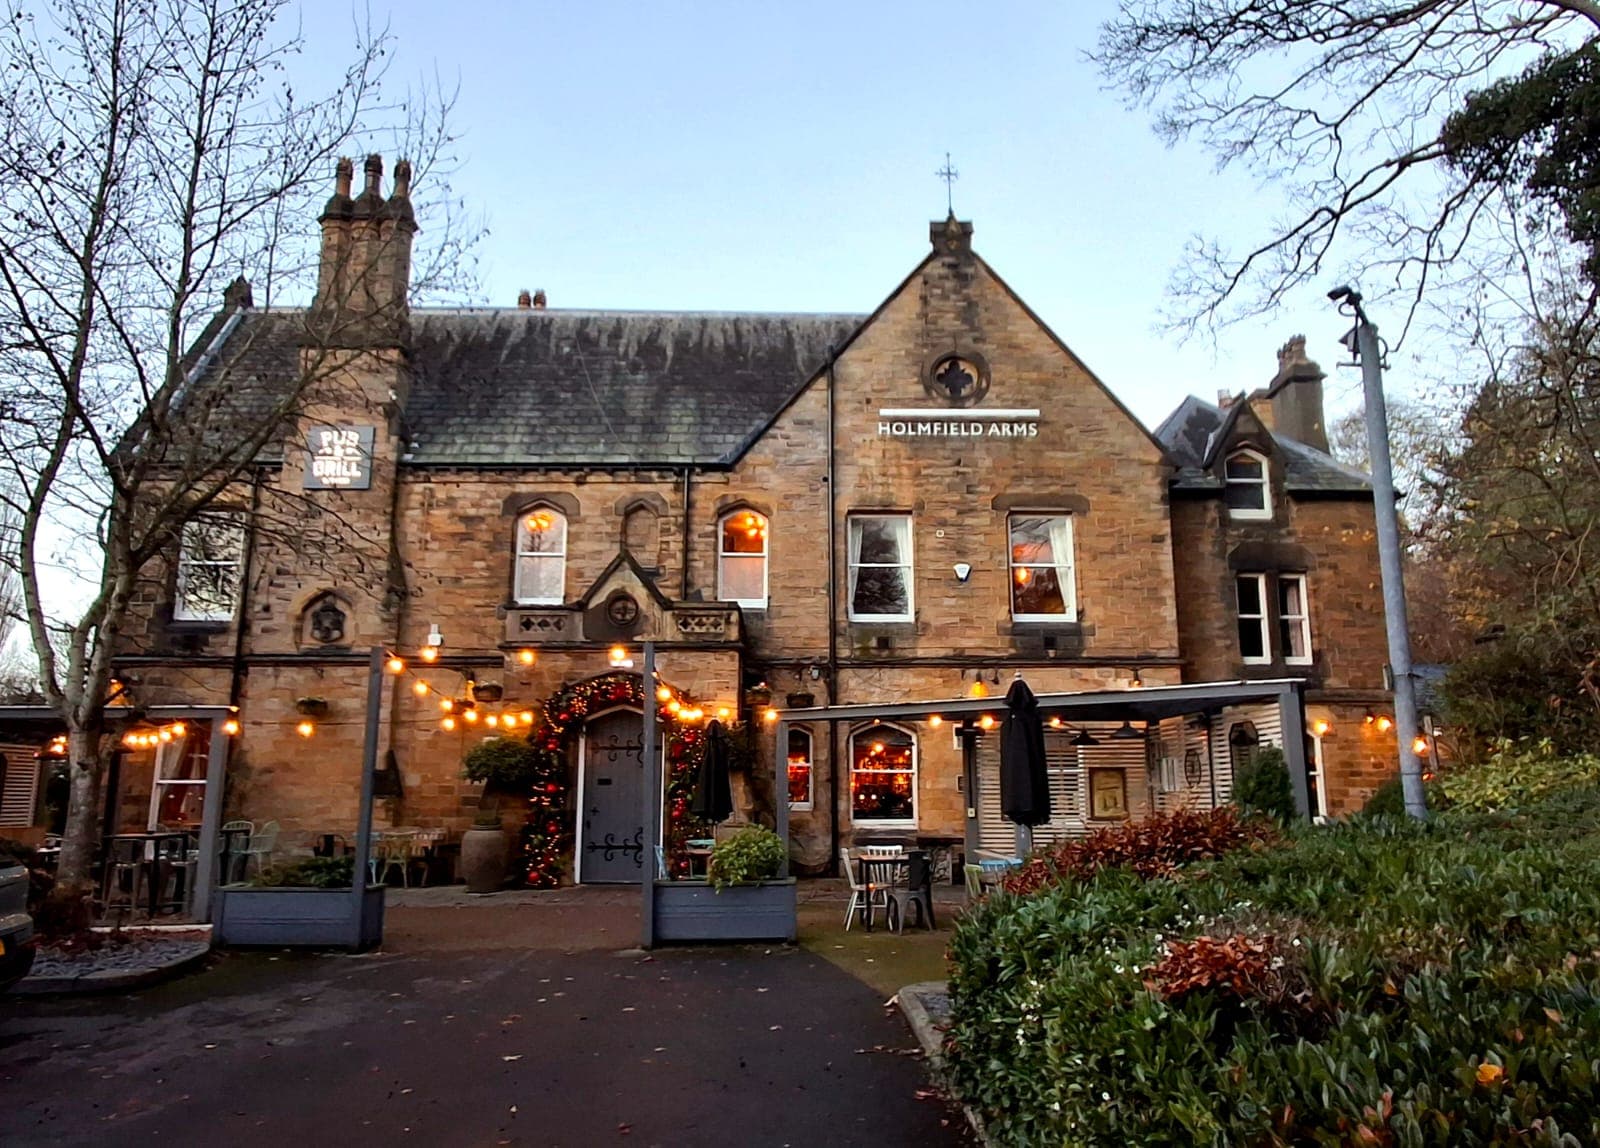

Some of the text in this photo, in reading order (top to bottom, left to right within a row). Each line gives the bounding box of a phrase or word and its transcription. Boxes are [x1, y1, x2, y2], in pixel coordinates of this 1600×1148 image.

[878, 421, 1038, 436] HOLMFIELD ARMS
[320, 430, 360, 447] PUB
[312, 460, 362, 477] GRILL
